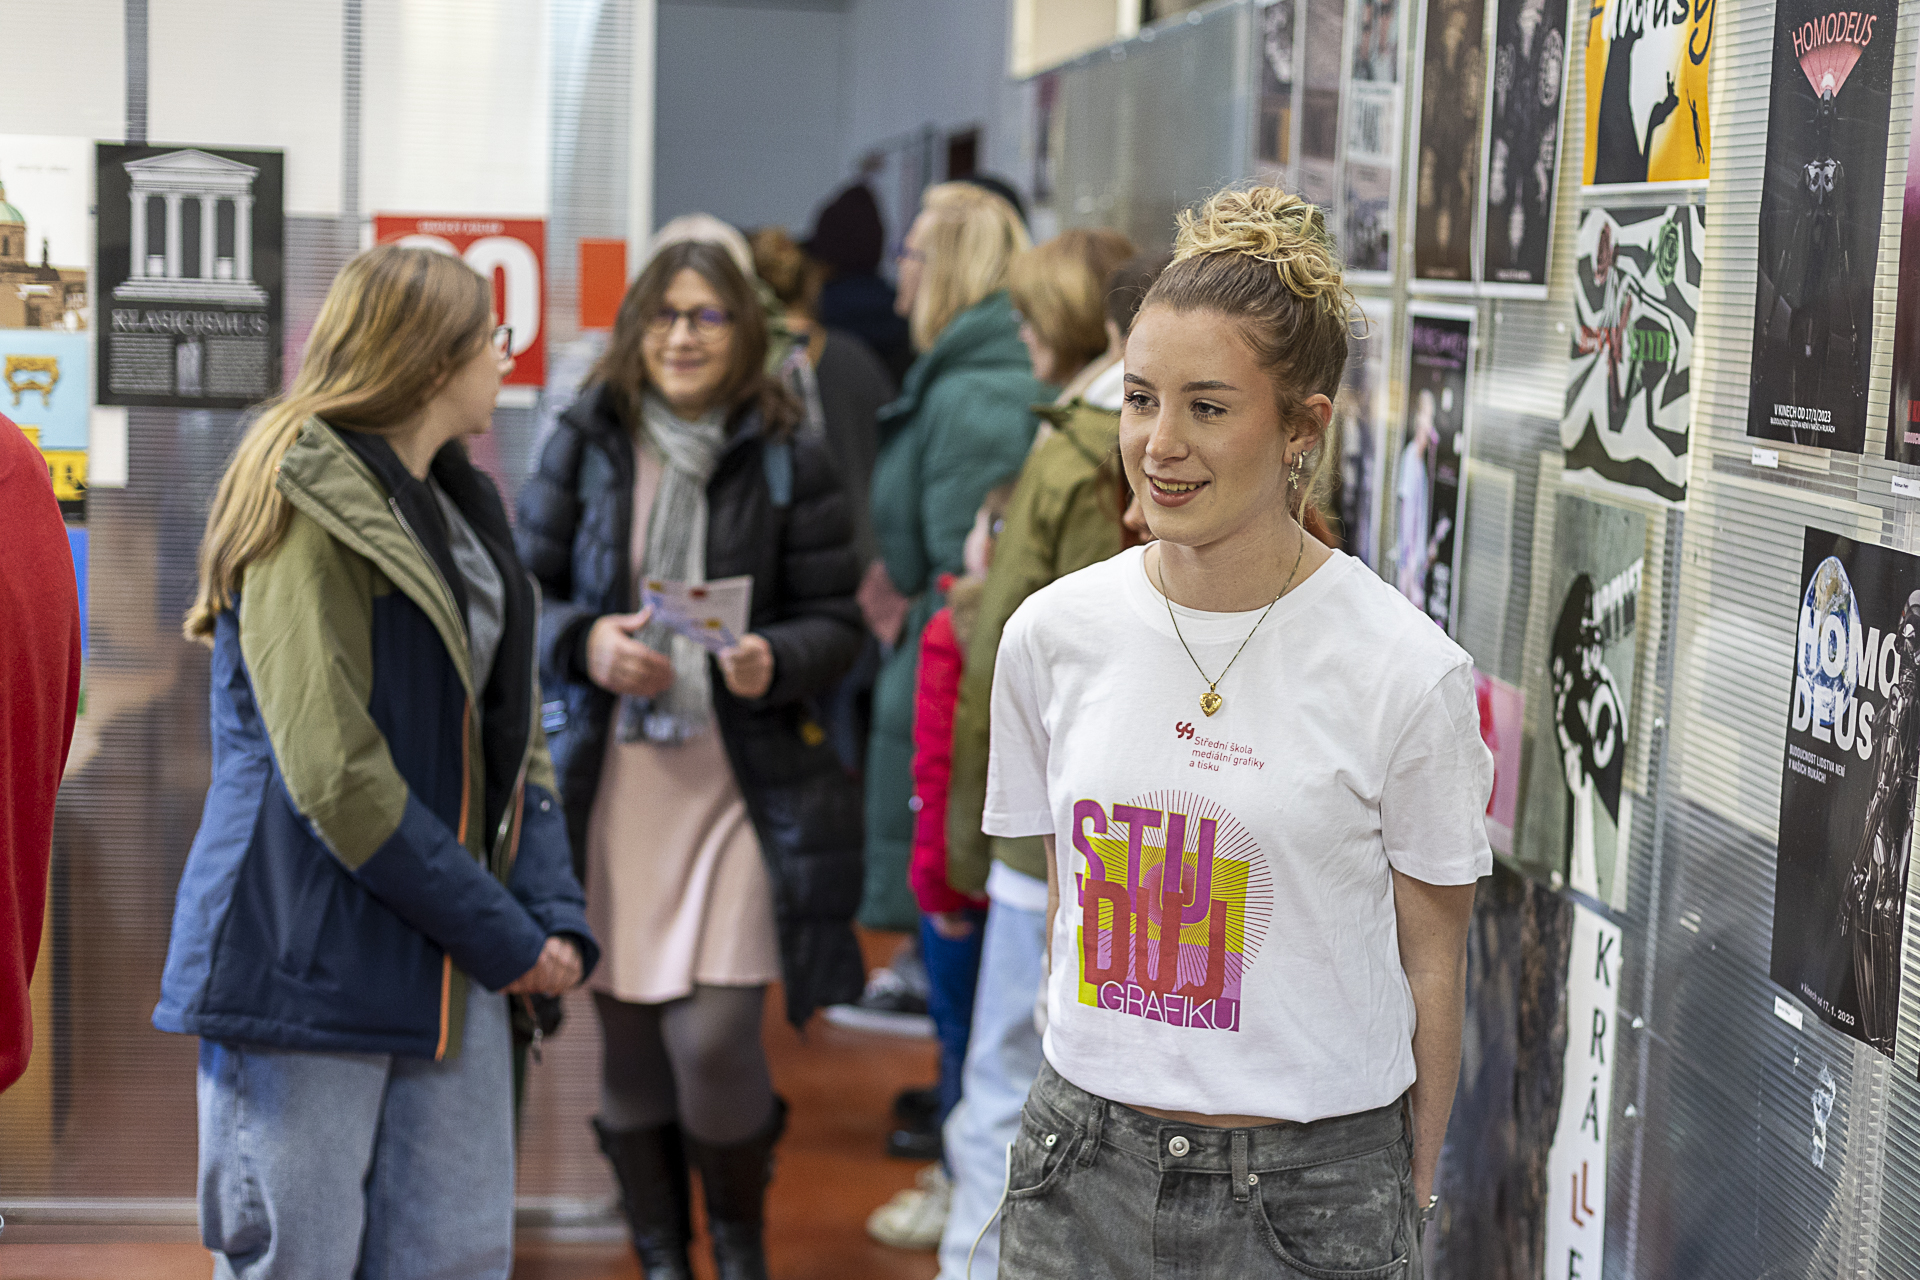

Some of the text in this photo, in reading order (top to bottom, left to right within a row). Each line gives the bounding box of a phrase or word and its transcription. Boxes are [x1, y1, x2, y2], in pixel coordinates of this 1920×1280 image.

[1792, 11, 1878, 58] HOMODEUS
[1797, 407, 1805, 419] OD
[1798, 605, 1901, 699] HOMO
[1791, 675, 1875, 761] DEUS
[1194, 736, 1253, 755] Střední škola
[1191, 749, 1265, 770] mediální grafiky
[1197, 759, 1220, 772] tisku
[1100, 980, 1236, 1031] GRAFIKU
[1838, 1010, 1855, 1026] 2023
